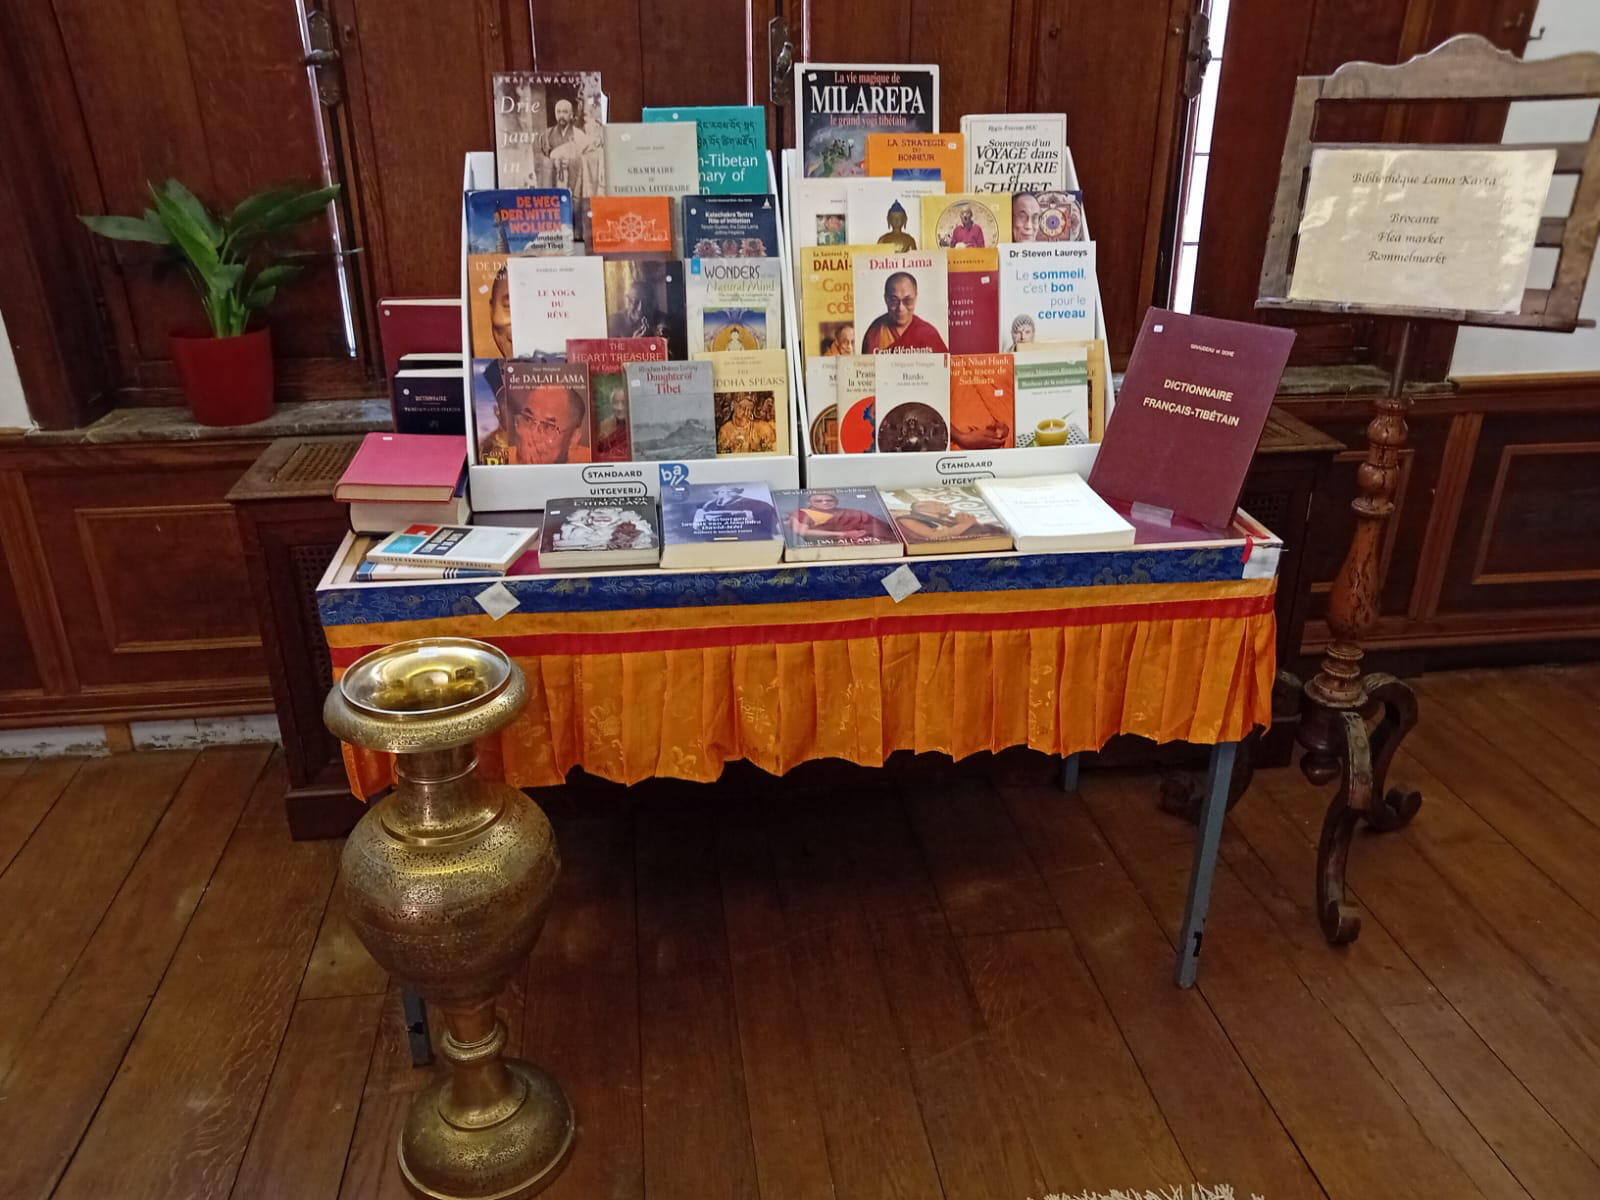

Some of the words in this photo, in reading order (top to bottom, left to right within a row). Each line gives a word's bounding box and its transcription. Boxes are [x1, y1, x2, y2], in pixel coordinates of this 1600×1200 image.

[834, 72, 845, 84] La
[846, 72, 858, 84] vie
[858, 73, 890, 86] magique
[891, 72, 901, 84] de
[501, 96, 541, 114] Drie
[810, 86, 926, 114] MILAREPA
[503, 128, 539, 146] jaar
[887, 139, 898, 147] LA
[989, 139, 1031, 148] Souvenirs
[977, 146, 1028, 160] VOYAGE
[1030, 148, 1059, 160] dans
[974, 163, 984, 175] la
[984, 160, 1059, 175] TARTARIE
[732, 168, 746, 181] of
[1422, 174, 1456, 185] Lama
[517, 196, 532, 208] DE
[533, 195, 561, 208] WEG
[501, 208, 524, 221] DER
[525, 208, 561, 220] WITTE
[1390, 213, 1441, 224] Brocante
[510, 221, 561, 233] WOLKEN
[1378, 231, 1402, 243] Flea
[1405, 231, 1445, 244] market
[1009, 250, 1019, 258] Dr
[1022, 249, 1052, 257] Steven
[1054, 249, 1087, 258] Laureys
[1367, 250, 1446, 264] Rommelmarkt
[476, 262, 490, 271] DE
[902, 257, 933, 269] Lama
[705, 265, 761, 280] WONDERS
[1016, 270, 1029, 280] Le
[537, 289, 547, 297] LE
[552, 289, 576, 297] YOGA
[1051, 282, 1074, 293] bon
[551, 300, 563, 308] DU
[1050, 298, 1074, 309] pour
[1077, 296, 1086, 305] le
[1038, 310, 1086, 319] cerveau
[609, 342, 624, 350] THE
[572, 352, 608, 362] HEART
[612, 353, 663, 361] TREASURE
[968, 357, 986, 366] Nhat
[988, 356, 1009, 366] Hanh
[647, 372, 682, 382] Daughter
[684, 371, 692, 380] of
[963, 367, 973, 376] les
[997, 366, 1007, 375] de
[510, 375, 521, 384] de
[556, 374, 585, 383] LAMA
[749, 376, 785, 386] SPEAKS
[848, 379, 855, 387] la
[657, 384, 681, 395] Tibet
[1163, 378, 1234, 403] DICTIONNAIRE
[1142, 396, 1240, 428] FRANÇAIS-TIBÉTAIN
[941, 461, 993, 470] STANDAARD
[588, 470, 643, 479] STANDAARD
[942, 477, 977, 485] UITGEV
[590, 487, 642, 496] UITGEVERIJ
